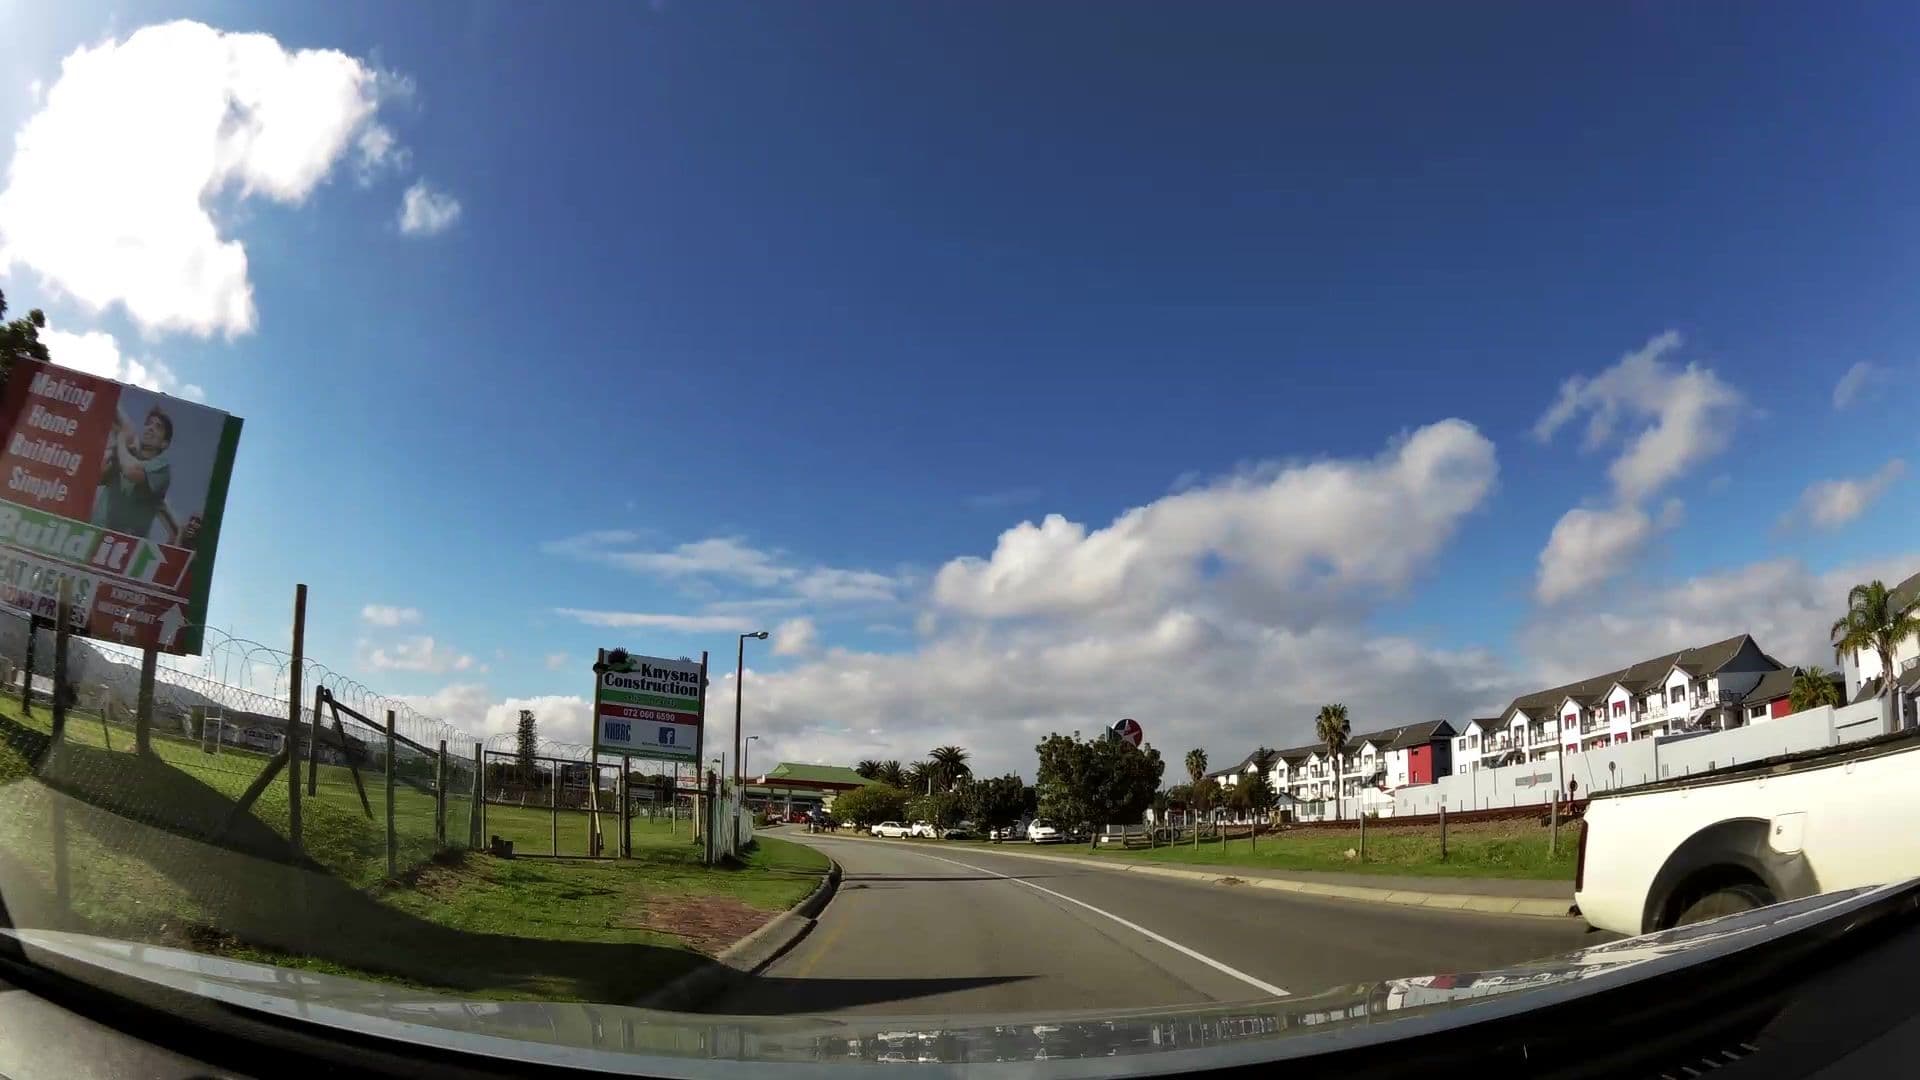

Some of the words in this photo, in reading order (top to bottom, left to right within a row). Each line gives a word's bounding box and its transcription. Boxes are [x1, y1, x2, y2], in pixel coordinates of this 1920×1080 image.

[28, 371, 96, 412] Making
[28, 404, 79, 437] Home
[9, 431, 83, 476] Building
[8, 465, 68, 501] Simple
[0, 505, 96, 561] Build
[92, 525, 129, 570] it
[32, 565, 90, 607] DES
[37, 596, 87, 625] PRES
[604, 672, 697, 697] Construction
[641, 663, 698, 684] Knysna
[623, 708, 638, 717] 072
[639, 710, 654, 719] 060
